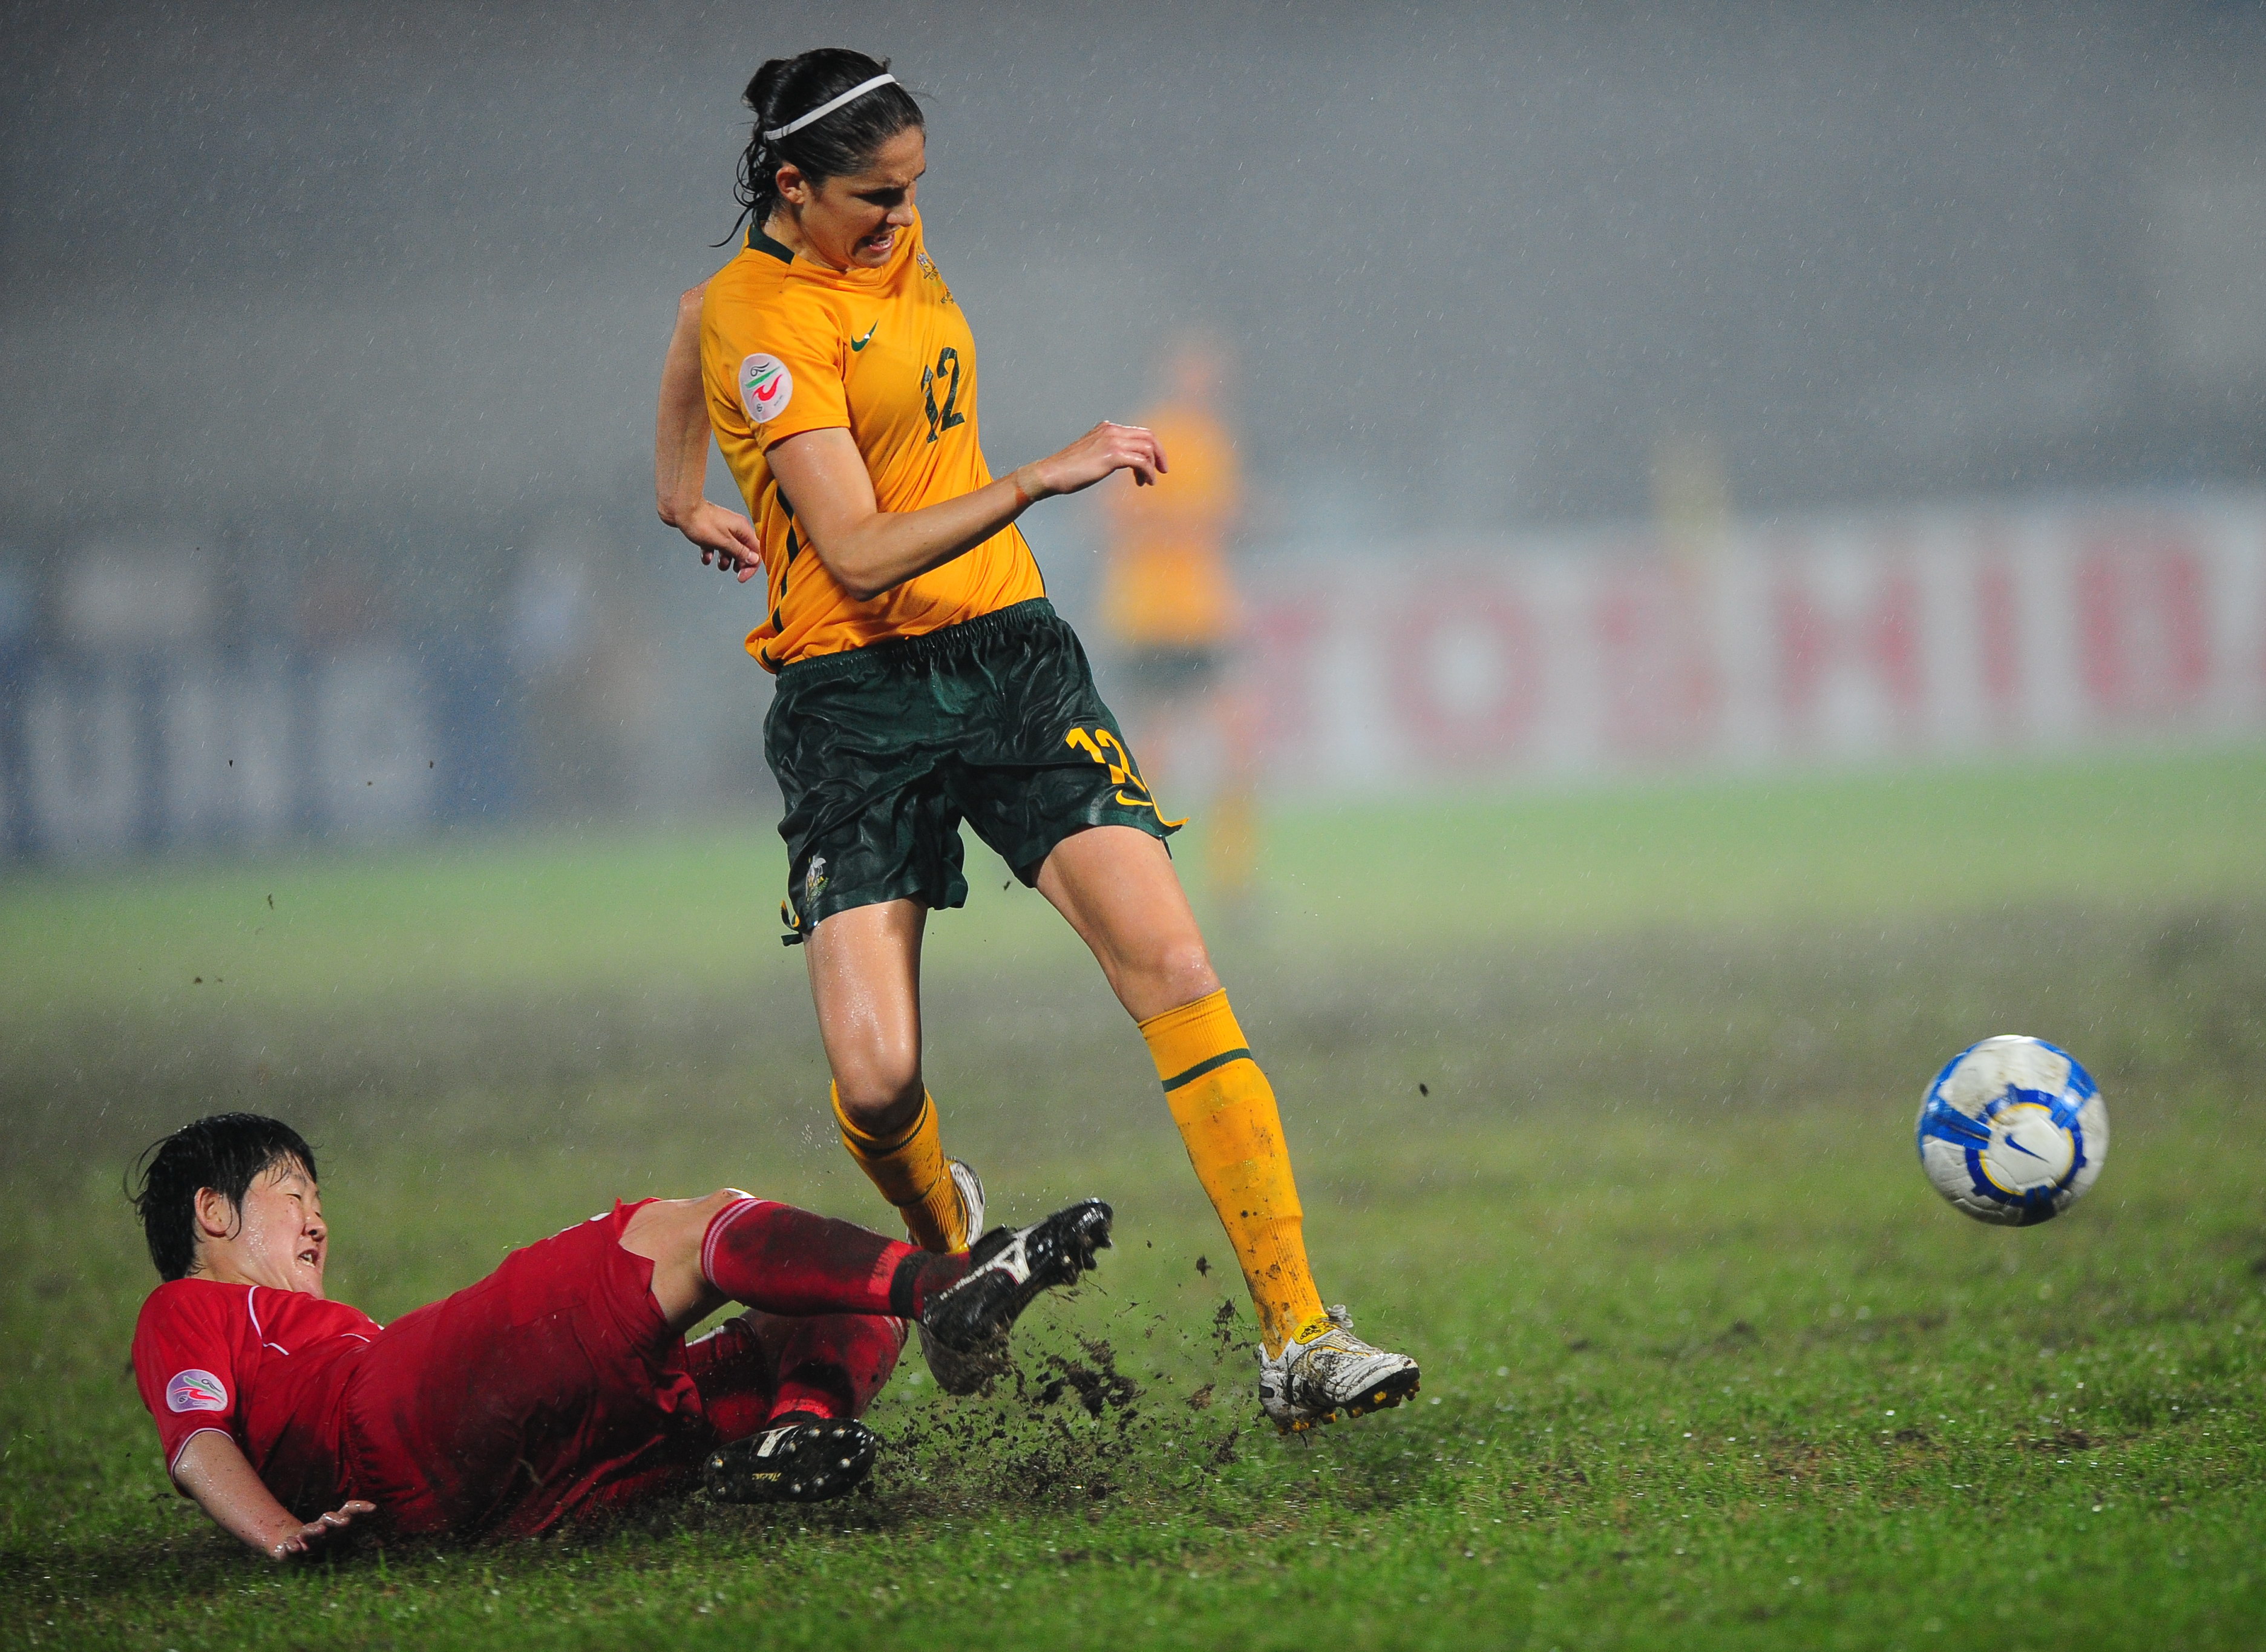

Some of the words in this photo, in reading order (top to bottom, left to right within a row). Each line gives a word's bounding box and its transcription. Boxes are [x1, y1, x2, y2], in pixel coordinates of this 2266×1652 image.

[920, 347, 965, 444] 12
[1243, 523, 2266, 772] TOSHIB
[1066, 727, 1147, 793] 12
